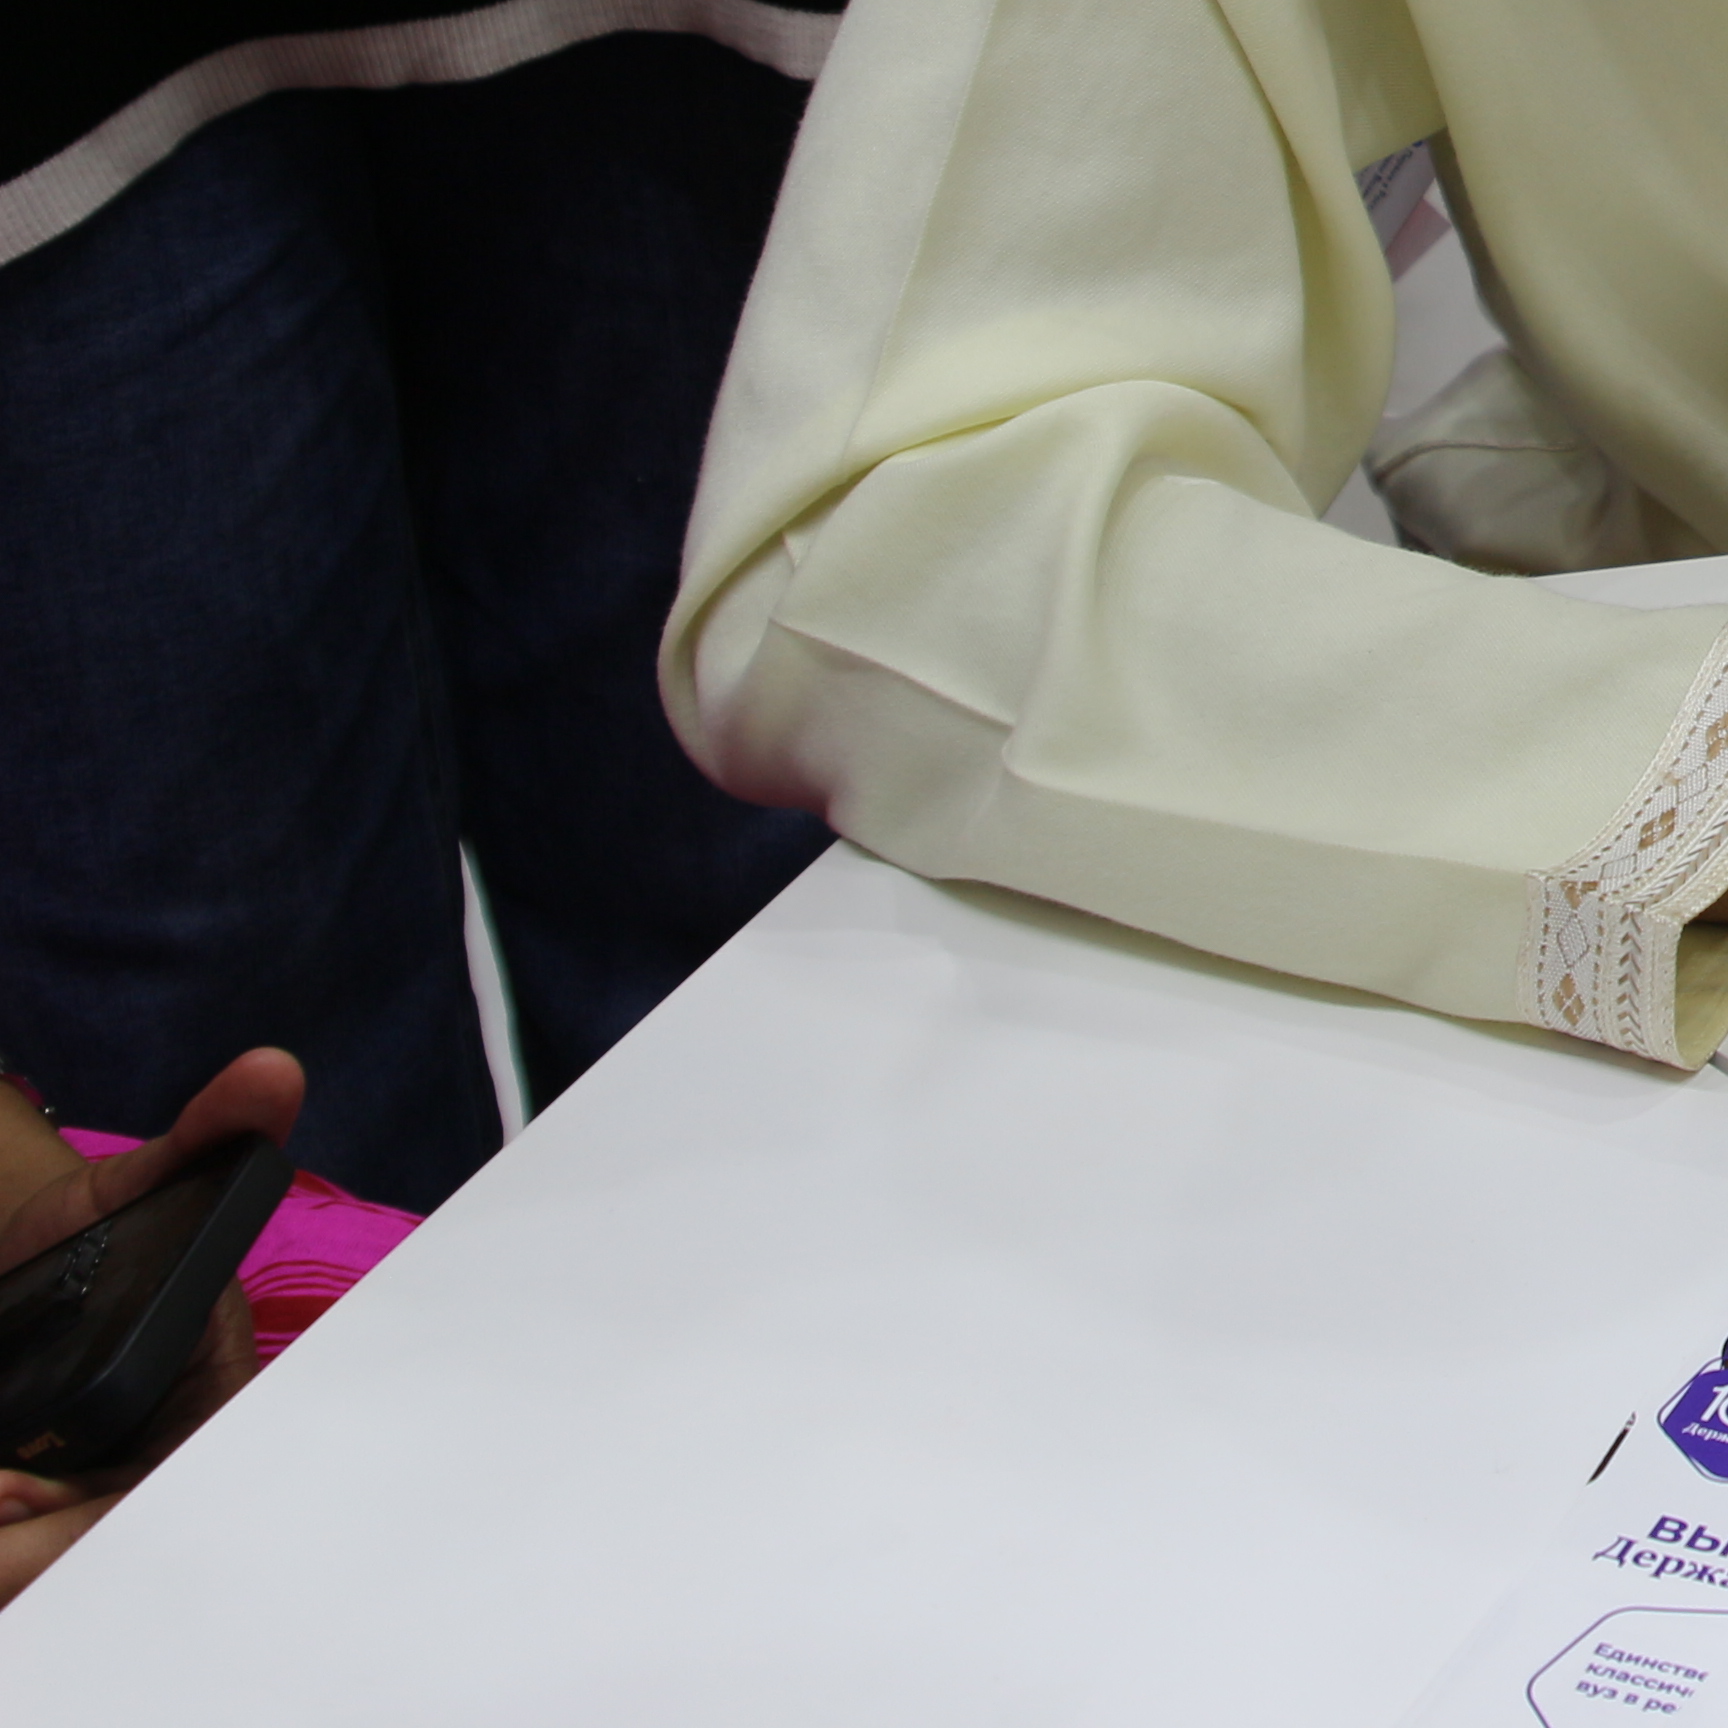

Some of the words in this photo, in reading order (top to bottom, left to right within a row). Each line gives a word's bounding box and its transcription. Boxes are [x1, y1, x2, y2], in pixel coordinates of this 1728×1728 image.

[1575, 1679, 1619, 1699] вуз
[1622, 1692, 1640, 1706] в
[1642, 1696, 1680, 1715] ре
[1585, 1662, 1695, 1699] классич
